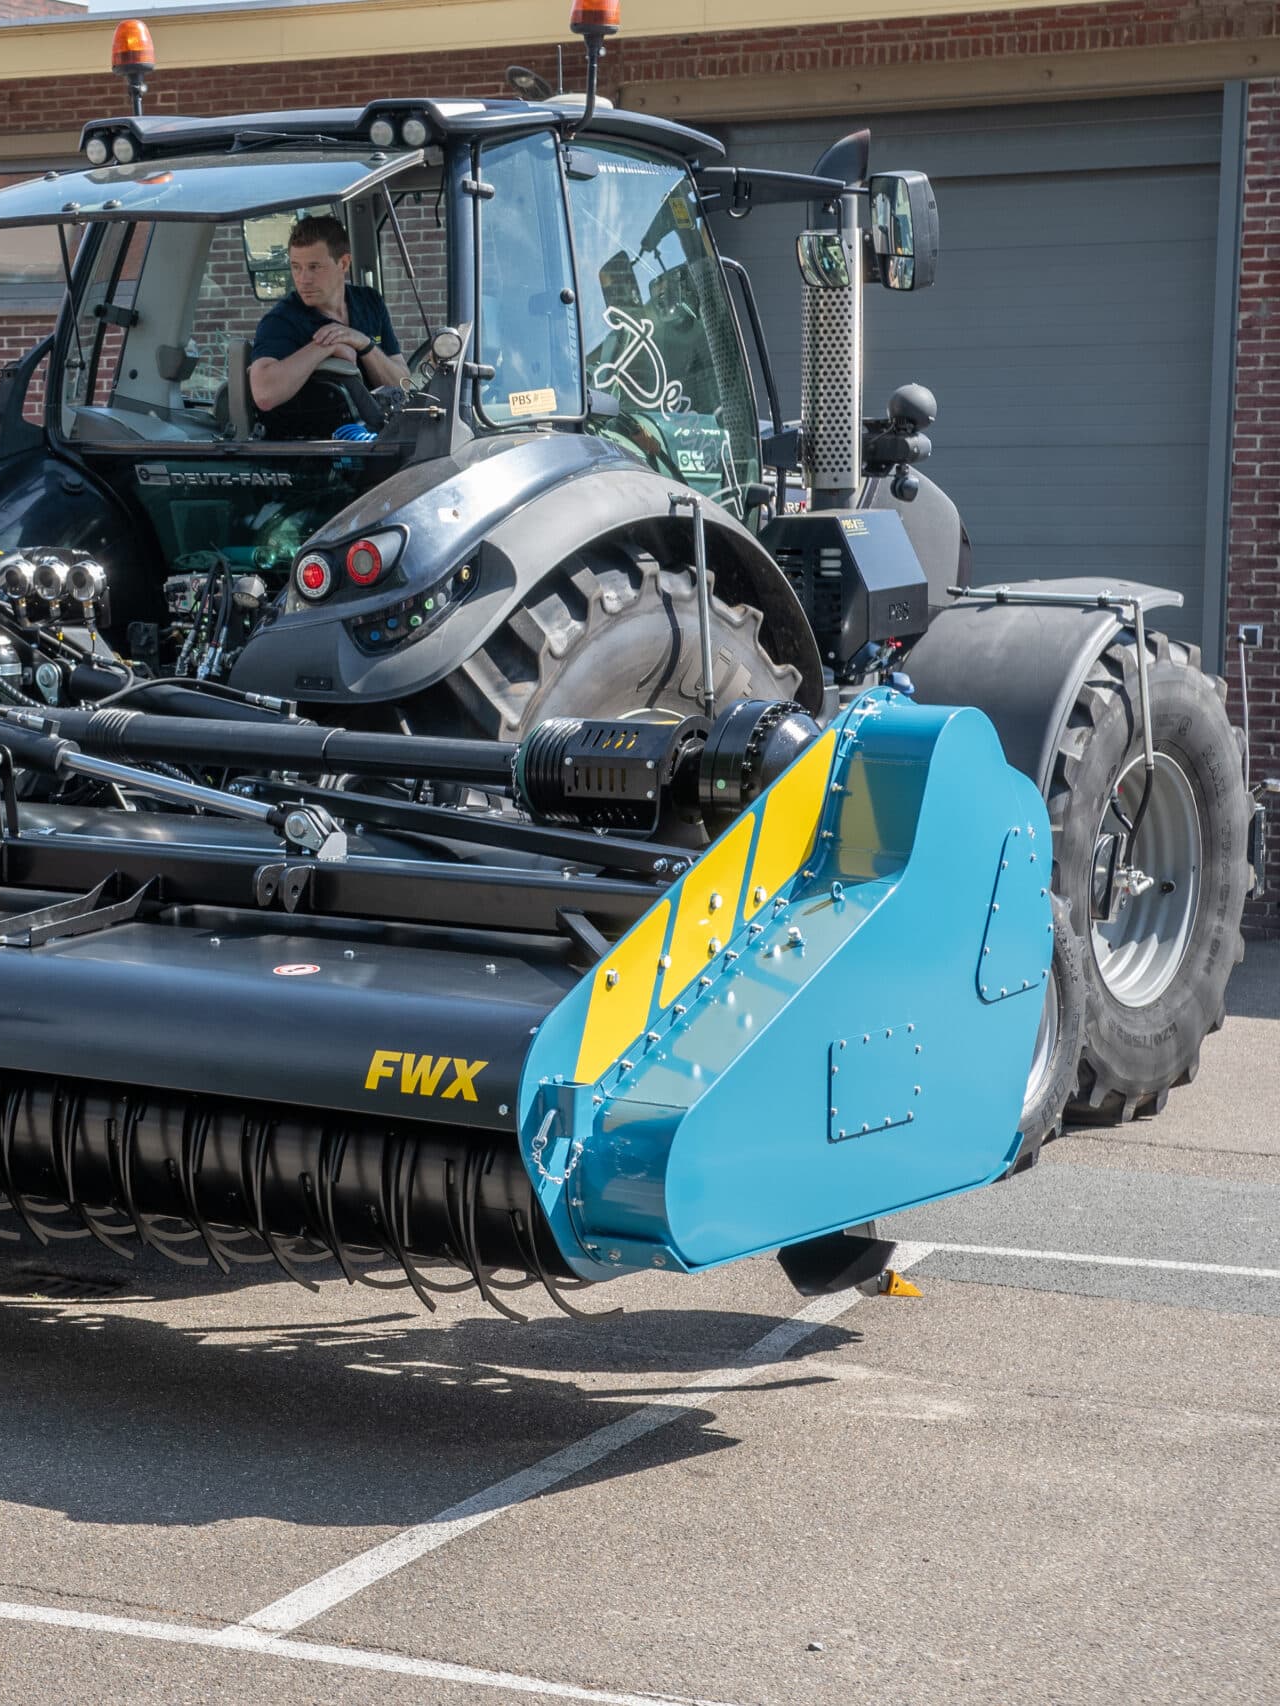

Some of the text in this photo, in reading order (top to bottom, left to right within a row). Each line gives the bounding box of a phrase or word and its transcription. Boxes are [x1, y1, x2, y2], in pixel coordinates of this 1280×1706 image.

[511, 394, 532, 406] PBS
[170, 472, 293, 487] DEUTZ-FAHR
[888, 601, 910, 621] PBS
[364, 1049, 489, 1103] FWX
